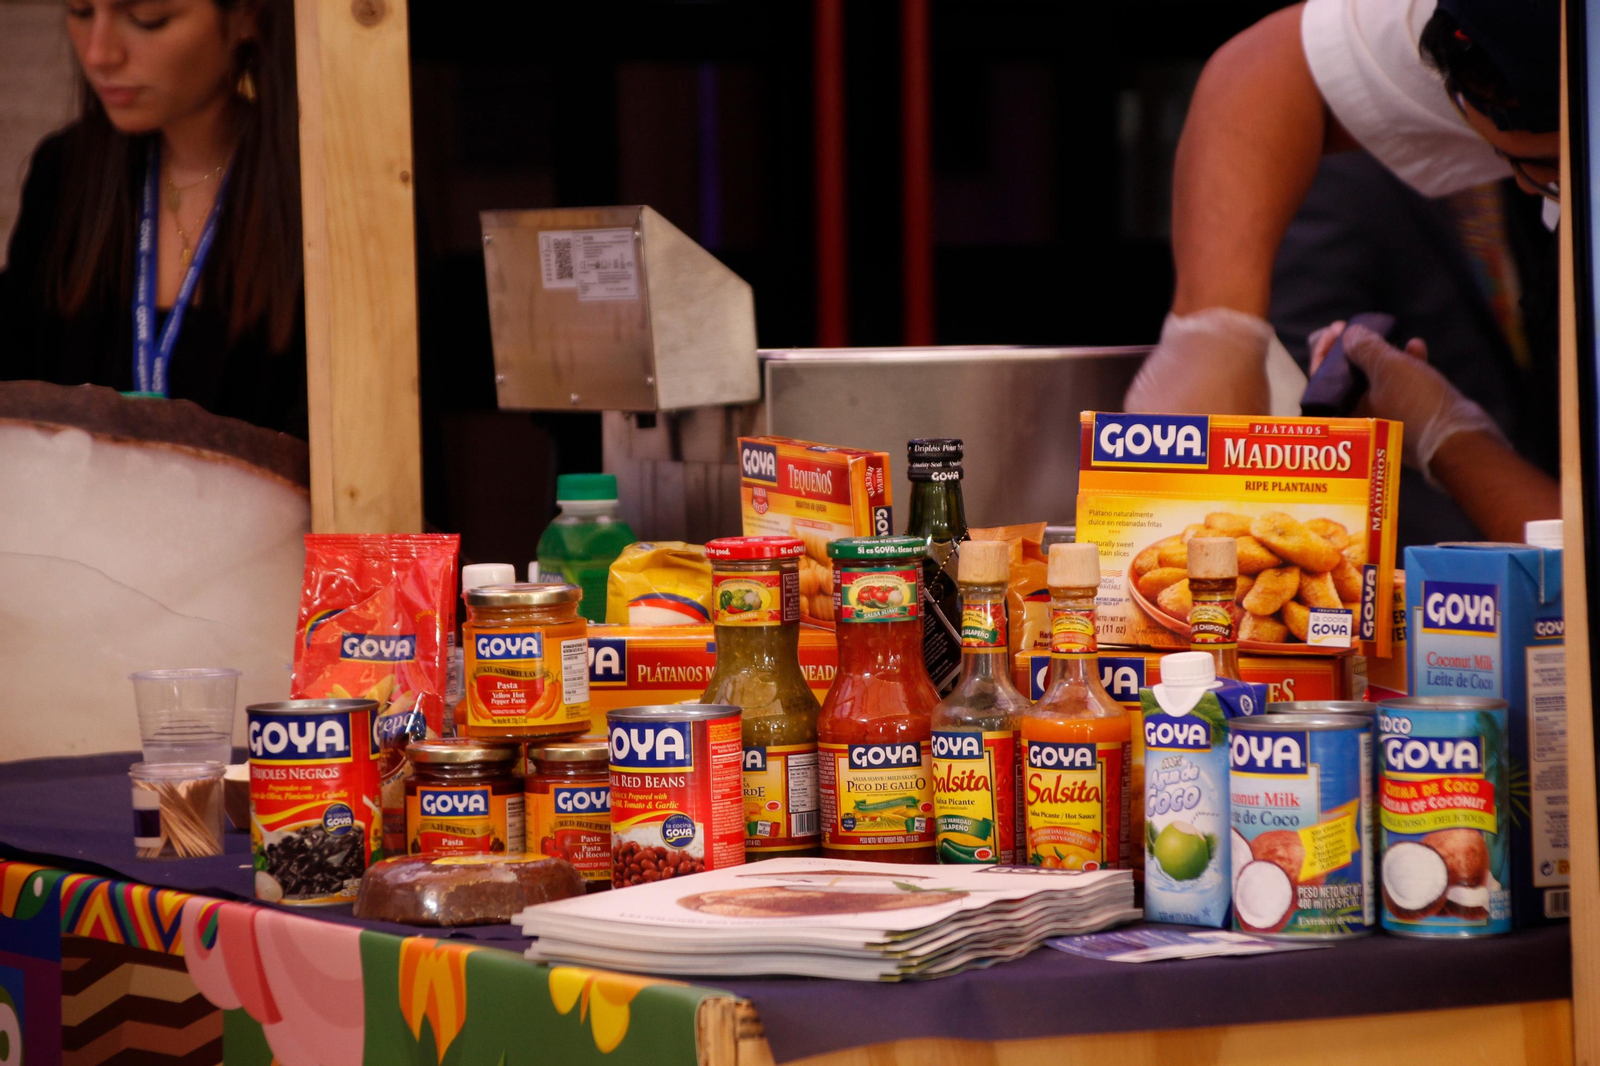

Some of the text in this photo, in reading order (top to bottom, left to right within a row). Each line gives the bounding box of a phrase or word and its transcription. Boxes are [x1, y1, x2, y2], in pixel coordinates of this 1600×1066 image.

[1255, 423, 1322, 435] PLÁTANOS
[1100, 422, 1202, 458] GOYA
[914, 444, 957, 454] Dripless Pour
[1223, 437, 1352, 472] MADUROS
[742, 448, 775, 477] GOYA
[787, 463, 832, 496] TEQUEÑOS
[865, 464, 875, 497] RECETA
[875, 466, 884, 494] NUEVA
[931, 470, 960, 481] GOYA
[1245, 480, 1328, 494] RIPE PLANTAINS
[1372, 448, 1386, 531] MADUROS
[1088, 509, 1154, 518] Plátano naturalmente
[857, 546, 865, 554] Si
[1362, 569, 1376, 638] GOYA
[1426, 592, 1495, 627] GOYA
[863, 607, 899, 619] SALSA SUAVE
[1312, 613, 1348, 623] la cocina
[964, 629, 990, 640] JALAPEÑO
[1115, 625, 1127, 635] oz)
[1198, 623, 1230, 636] CHIPOTLE
[1311, 623, 1349, 636] GOYA
[343, 637, 411, 659] GOYA
[477, 636, 538, 658] GOYA
[1426, 651, 1495, 671] Coconut Milk
[495, 667, 536, 678] AMARILLO
[637, 661, 703, 683] PLÁTANOS
[496, 681, 518, 690] Pasta
[1426, 670, 1494, 691] Leite de Coco
[490, 698, 510, 706] Pepper
[512, 691, 525, 699] Hot
[249, 720, 346, 757] GOYA
[1145, 722, 1207, 745] GOYA
[608, 727, 685, 762] OYA
[931, 736, 980, 758] GOYA
[1228, 733, 1301, 768] OYA
[852, 744, 918, 768] GOYA
[1029, 745, 1093, 767] GOYA
[1386, 739, 1479, 770] GOYA
[288, 766, 339, 780] NEGROS
[932, 763, 990, 794] Salsita
[1180, 762, 1200, 782] de
[621, 774, 686, 789] RED BEANS
[846, 777, 926, 793] PICO DE GALLO
[1384, 778, 1480, 799] CREMA DE COCO
[627, 792, 668, 801] Prepared with
[1027, 773, 1101, 806] Salsita
[422, 794, 487, 815] GOYA
[623, 800, 679, 809] Tomato & Garlic
[948, 797, 975, 806] Picante
[1146, 784, 1202, 818] COCO
[1264, 791, 1301, 808] Milk
[1411, 799, 1427, 813] OF
[1427, 795, 1487, 810] COCONUT
[947, 817, 972, 826] VARIEDAD
[1040, 811, 1060, 819] Picante
[1242, 809, 1300, 827] de Coco
[1434, 813, 1486, 825] DELICIOUS
[326, 817, 352, 828] GOYA
[431, 822, 476, 836] AJÍ PANCA
[576, 821, 592, 829] HOT
[941, 823, 969, 832] JALAPEÑO
[580, 835, 602, 843] Paste
[665, 828, 693, 838] GOYA
[441, 838, 464, 846] Pasta
[585, 851, 610, 859] Rocoto
[1298, 885, 1353, 898] PESO NETO NET
[1298, 898, 1312, 910] 400
[1313, 898, 1324, 909] ml
[1298, 916, 1336, 926] Extracto
